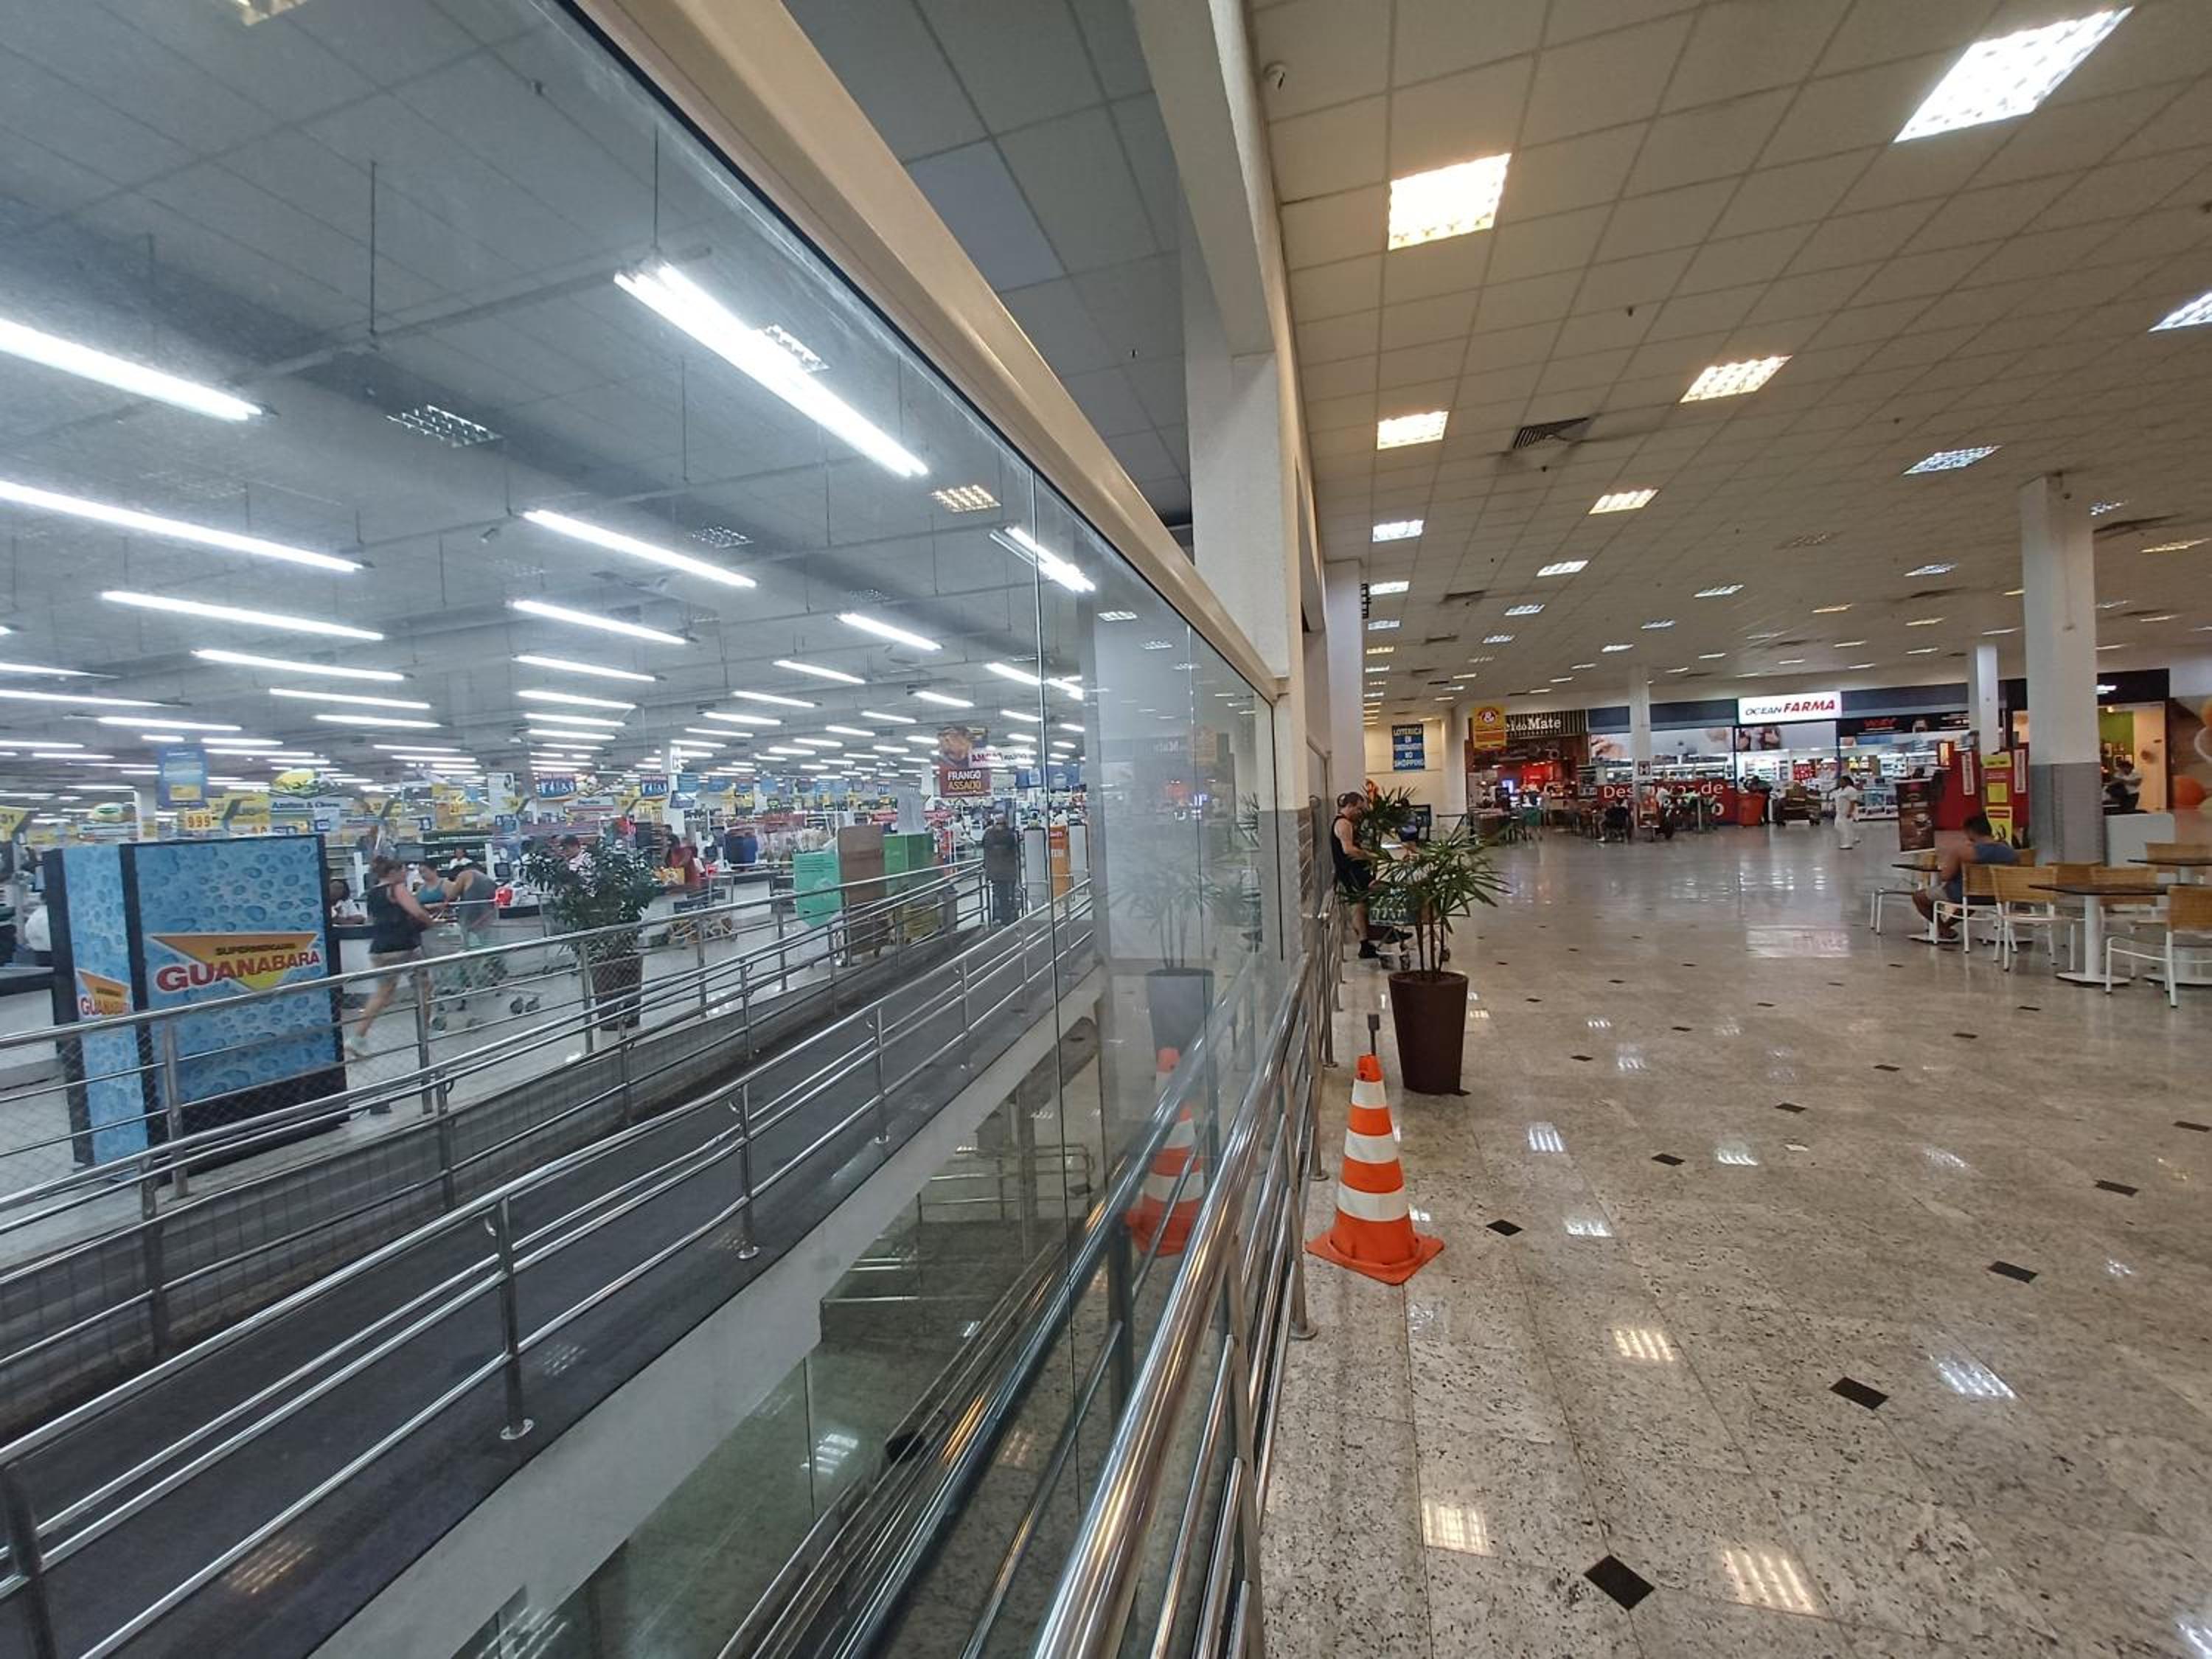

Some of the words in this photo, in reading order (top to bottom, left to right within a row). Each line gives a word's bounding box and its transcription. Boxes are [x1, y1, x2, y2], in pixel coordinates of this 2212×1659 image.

[1745, 707, 1781, 716] OCEAN
[1784, 699, 1835, 713] FARMA
[1527, 717, 1561, 731] Mate
[947, 770, 981, 781] FRANGO
[948, 780, 981, 790] ASSADO
[156, 950, 320, 992] GUANABARA
